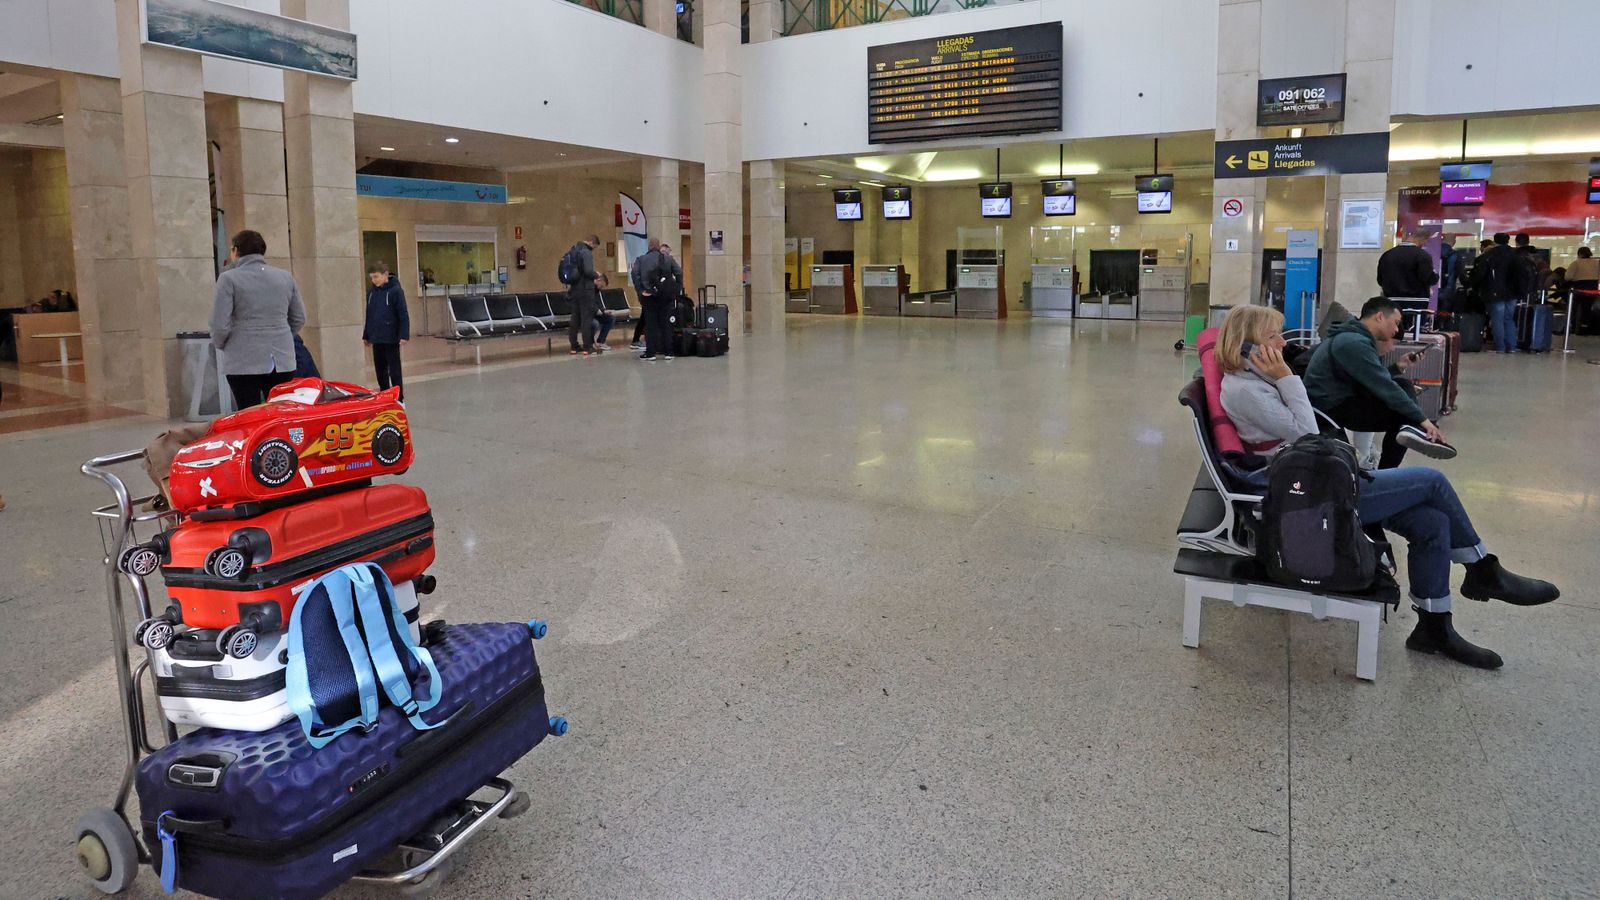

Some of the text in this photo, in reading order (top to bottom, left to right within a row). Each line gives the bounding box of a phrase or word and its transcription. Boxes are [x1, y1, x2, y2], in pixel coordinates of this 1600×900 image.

[937, 36, 974, 48] LLEGADAS
[937, 44, 968, 54] ARRIVALS
[1279, 88, 1325, 100] 091 062
[1275, 143, 1302, 151] Ankunft
[1274, 151, 1302, 159] Arrivals
[1274, 160, 1316, 169] Llegadas
[360, 184, 372, 192] TUI
[1055, 183, 1062, 192] 5
[1152, 179, 1159, 188] 6
[894, 189, 900, 199] 3
[992, 186, 999, 195] 4
[844, 192, 851, 201] 2
[325, 423, 354, 451] 95
[376, 427, 401, 439] LIGHTYEAR
[258, 442, 292, 456] LIGHTYEAR
[259, 470, 293, 484] LIGHTYEAR
